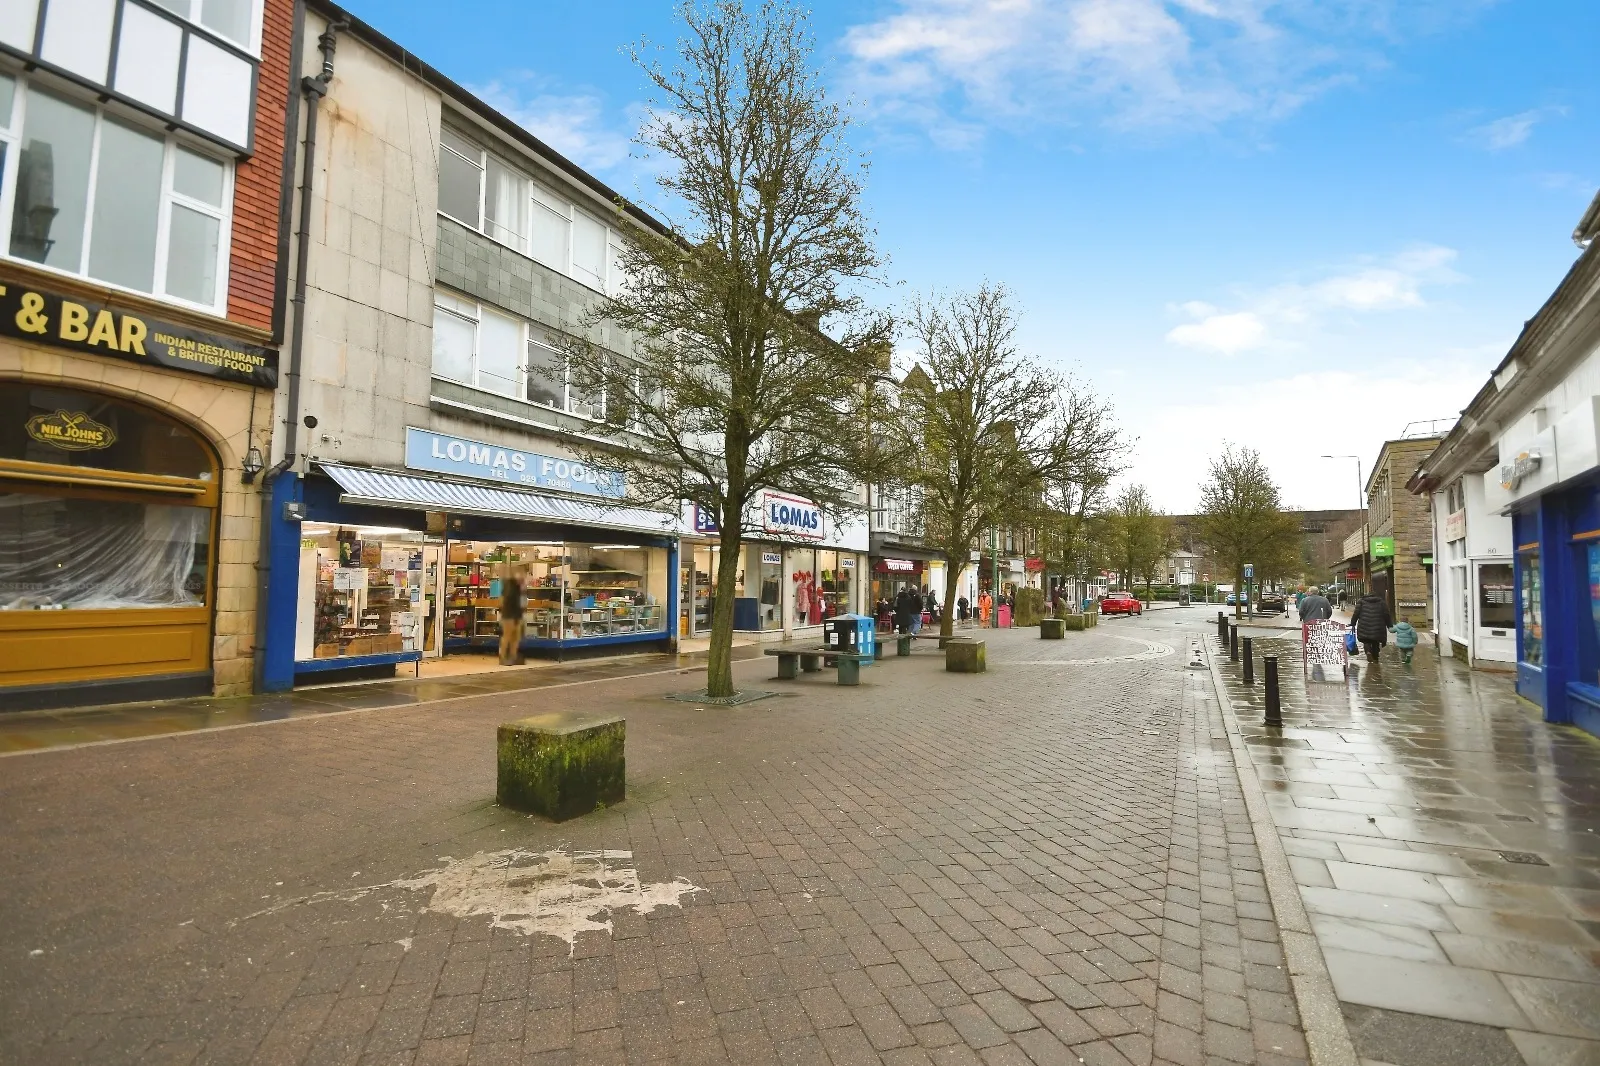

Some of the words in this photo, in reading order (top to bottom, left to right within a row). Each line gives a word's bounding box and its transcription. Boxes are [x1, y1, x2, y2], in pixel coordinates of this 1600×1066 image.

[15, 292, 48, 334] &
[60, 300, 147, 356] BAR
[154, 332, 196, 351] INDIAN
[197, 342, 266, 367] RESTAURANT
[167, 346, 177, 357] &
[178, 349, 223, 367] BRITISH
[224, 359, 255, 373] FOOD
[41, 423, 63, 436] NIK
[65, 427, 104, 441] JOHNS
[431, 437, 526, 472] LOMAS
[490, 468, 509, 479] TEL
[771, 503, 818, 529] LOMAS
